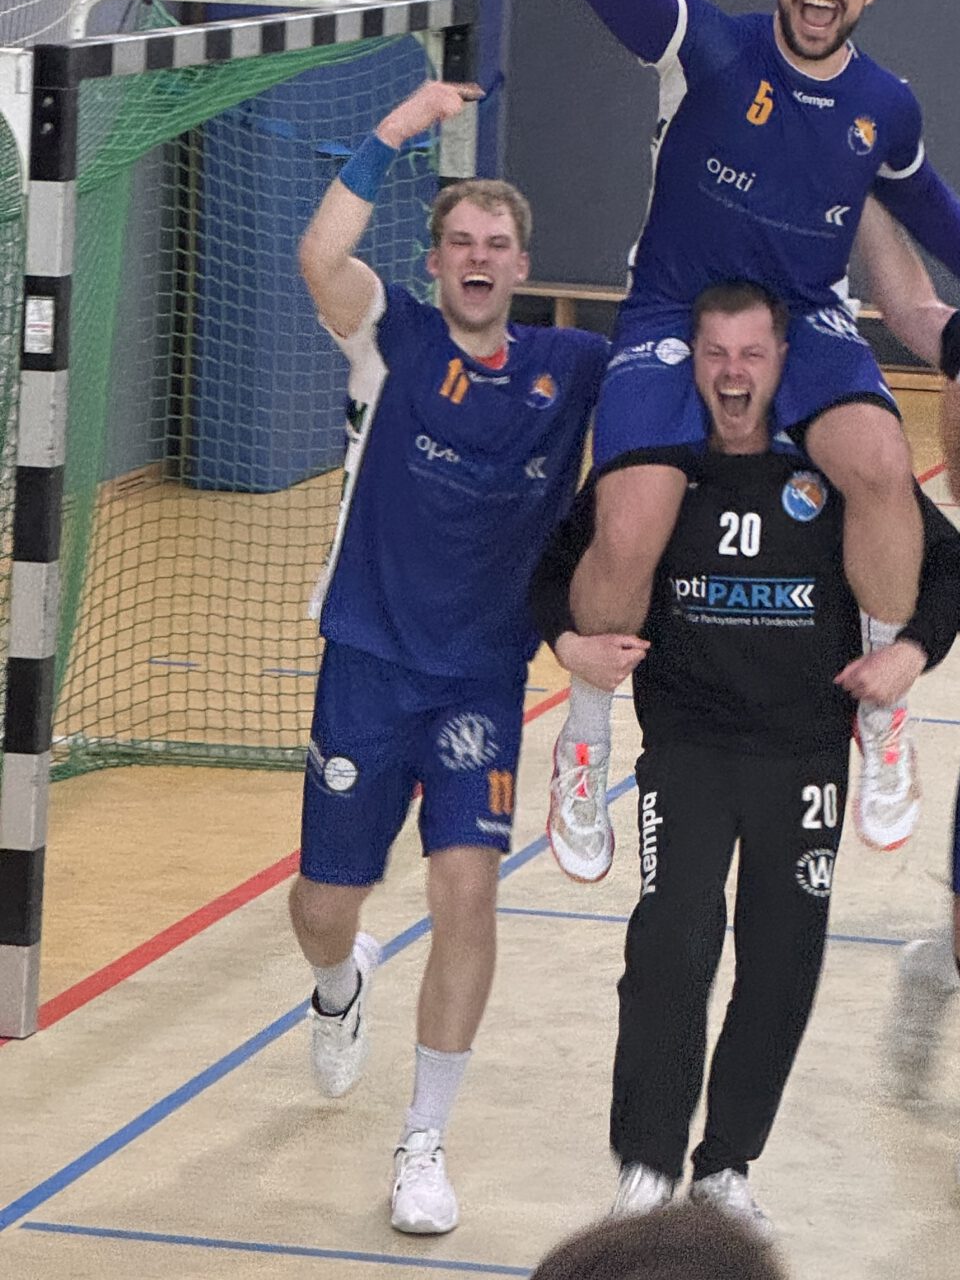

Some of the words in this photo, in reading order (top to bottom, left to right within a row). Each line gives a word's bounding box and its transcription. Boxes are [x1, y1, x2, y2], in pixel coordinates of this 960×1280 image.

[746, 80, 774, 126] 5
[792, 90, 835, 109] Kempa
[718, 511, 762, 558] 20
[670, 574, 795, 608] ptiPARK
[801, 783, 838, 830] 20
[642, 791, 664, 896] Kempa
